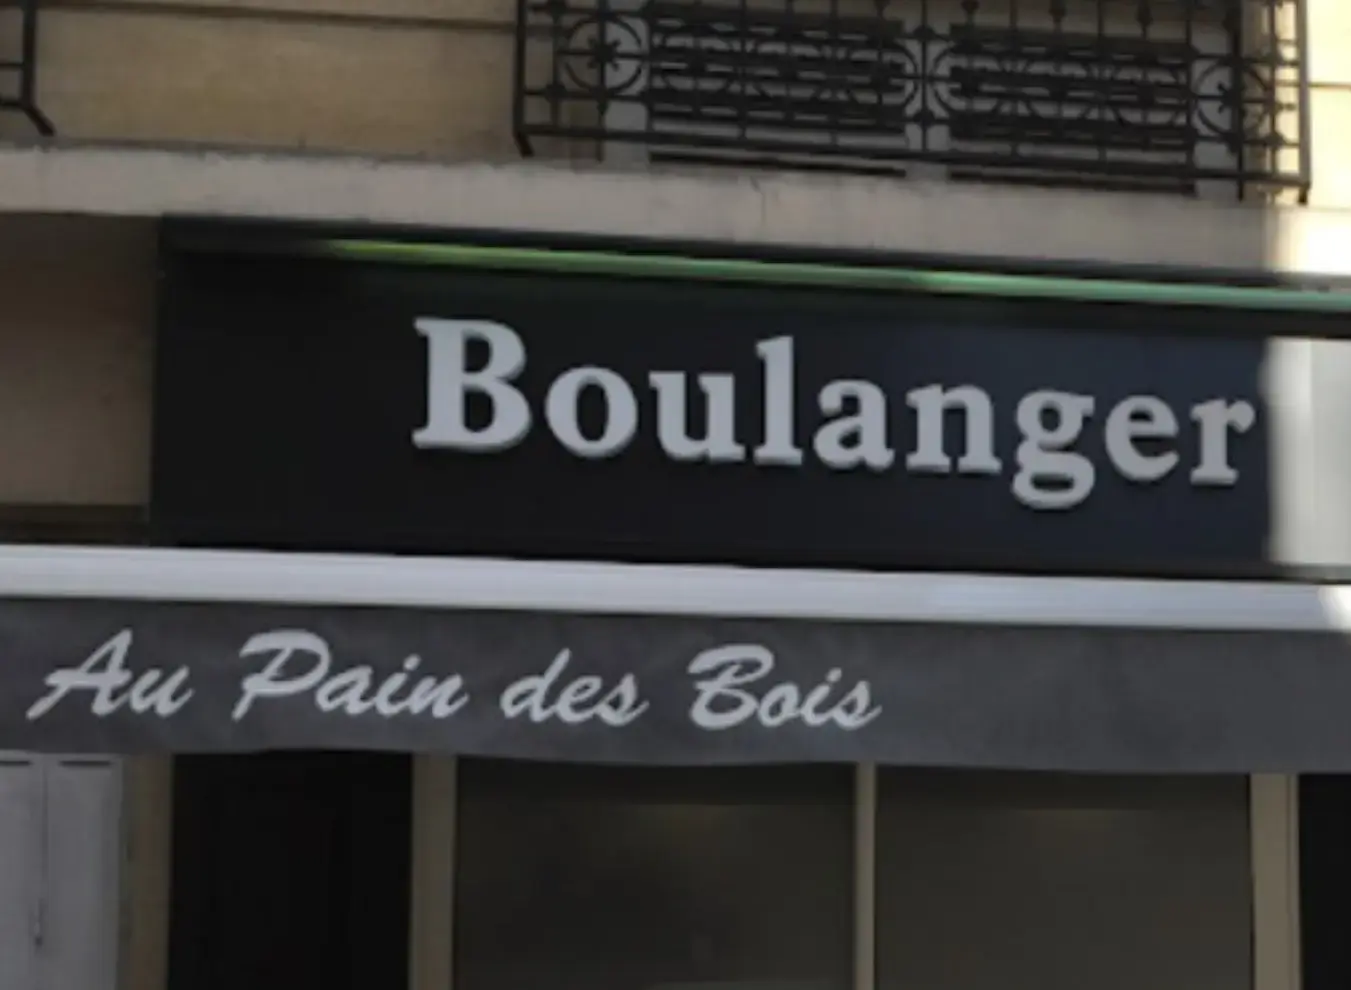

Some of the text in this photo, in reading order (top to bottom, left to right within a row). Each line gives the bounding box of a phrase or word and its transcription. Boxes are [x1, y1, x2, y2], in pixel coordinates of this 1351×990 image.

[411, 316, 1256, 511] Boulanger
[26, 627, 883, 732] Au Pain des Bois
